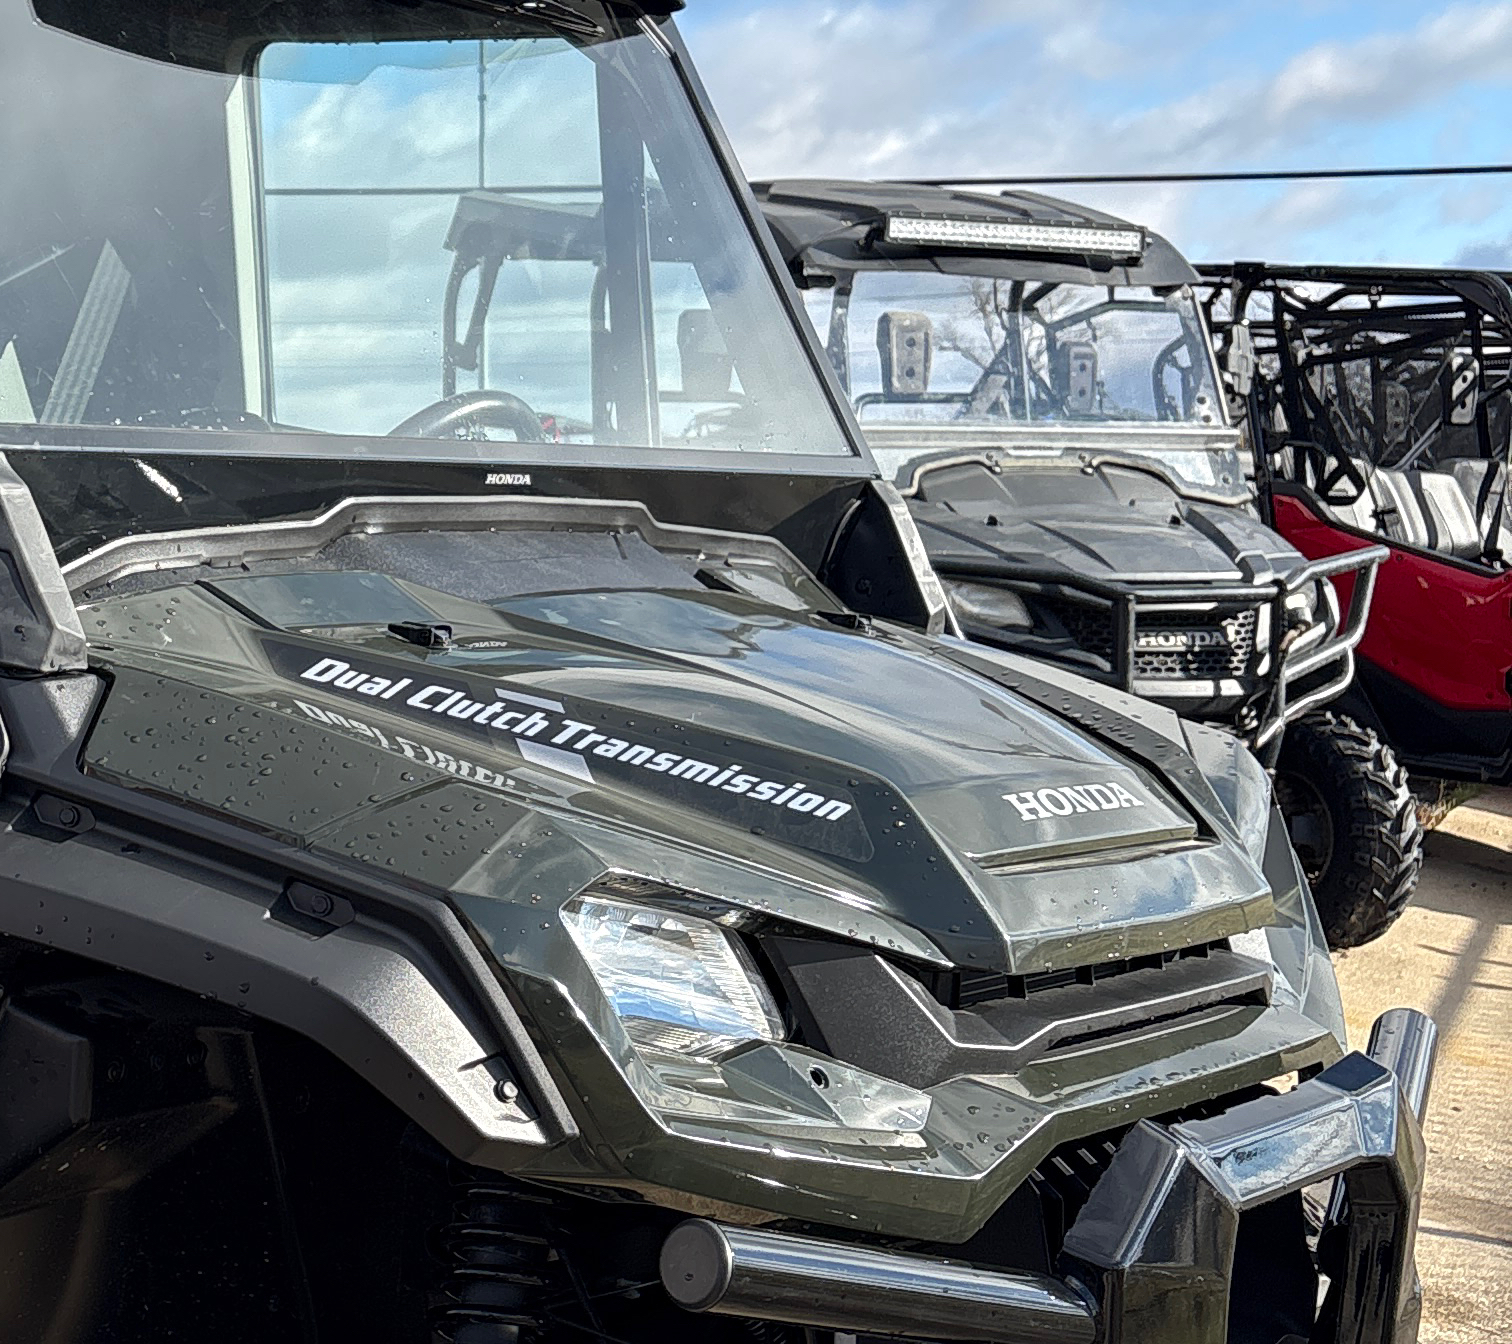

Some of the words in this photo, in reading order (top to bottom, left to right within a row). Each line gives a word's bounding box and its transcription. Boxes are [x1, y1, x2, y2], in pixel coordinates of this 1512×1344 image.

[484, 472, 531, 485] HONDA
[1136, 631, 1228, 646] HONDA
[300, 658, 413, 699] Dual
[406, 685, 549, 737] Clutch
[551, 719, 852, 821] Transmission
[1001, 782, 1144, 821] HONDA
